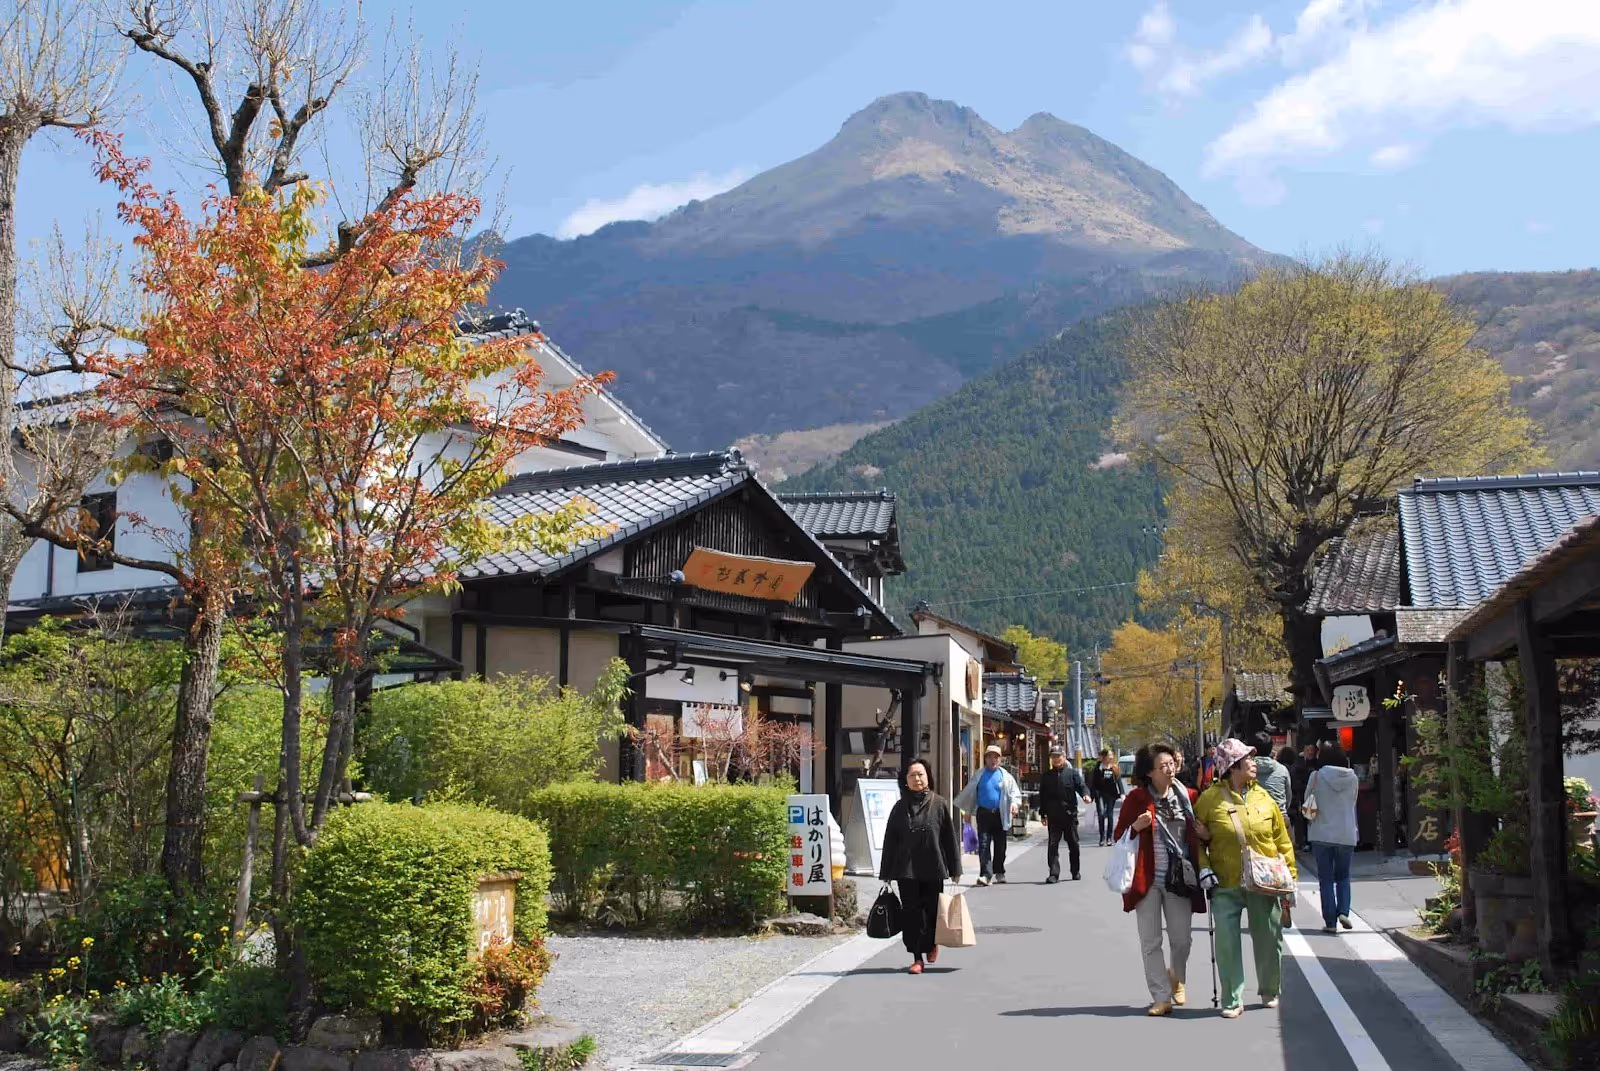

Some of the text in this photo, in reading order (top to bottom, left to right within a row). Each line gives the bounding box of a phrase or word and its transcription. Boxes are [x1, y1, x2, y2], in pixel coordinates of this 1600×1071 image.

[789, 806, 803, 822] P
[790, 835, 804, 887] 駐車場
[807, 803, 827, 885] はかり屋
